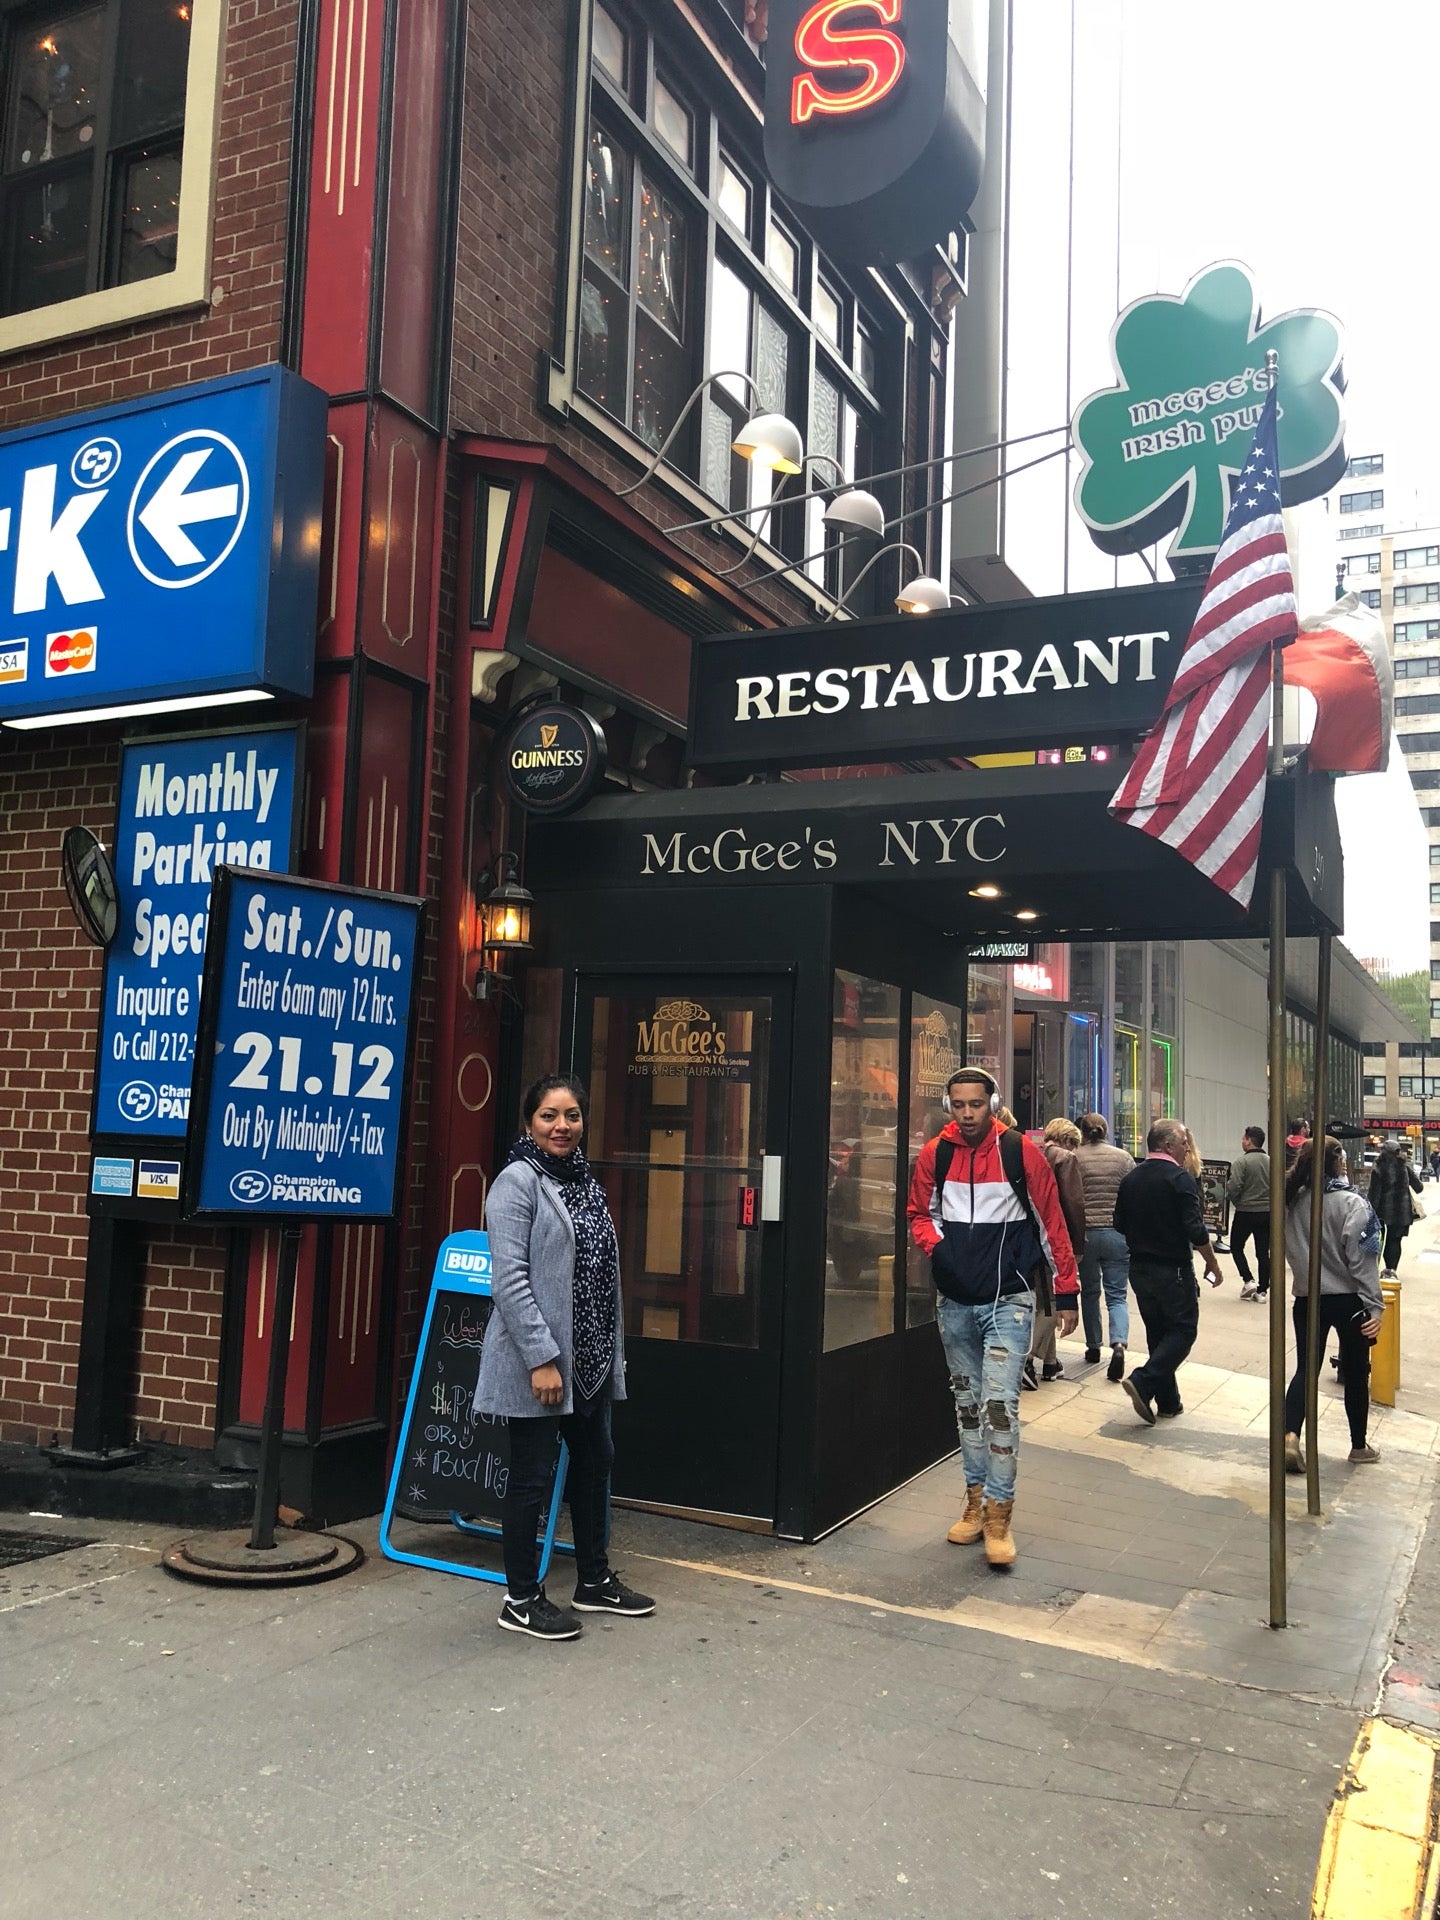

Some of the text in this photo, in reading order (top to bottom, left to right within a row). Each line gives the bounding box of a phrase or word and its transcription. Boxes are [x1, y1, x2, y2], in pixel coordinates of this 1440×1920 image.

[791, 0, 905, 124] S
[49, 644, 93, 662] MasterCard
[734, 631, 1170, 721] RESTAURANT
[511, 750, 584, 769] GUINNESS
[135, 750, 279, 823] Monthly
[640, 813, 1007, 874] McGee's NYC
[116, 975, 190, 1027] Inquire
[237, 961, 279, 1011] Enter
[281, 968, 315, 1016] 6am
[318, 986, 346, 1031] any
[351, 977, 369, 1022] 12
[371, 975, 397, 1026] hrs.
[113, 1031, 130, 1061] Or
[132, 1029, 157, 1061] Call
[637, 1021, 726, 1055] McGee's
[229, 1031, 394, 1100] 21.12
[628, 1065, 732, 1077] PUB & RESTAURANT
[704, 1056, 724, 1065] NYC
[223, 1102, 250, 1148] Out
[253, 1104, 275, 1160] By
[95, 1166, 131, 1175] AMERICAN
[102, 1177, 132, 1187] EXPRESS
[150, 1173, 169, 1185] VISA
[273, 1174, 337, 1188] Champion
[271, 1185, 362, 1204] PARKING
[447, 1252, 488, 1272] BUD
[424, 1424, 457, 1445] OR
[432, 1450, 482, 1483] Bud
